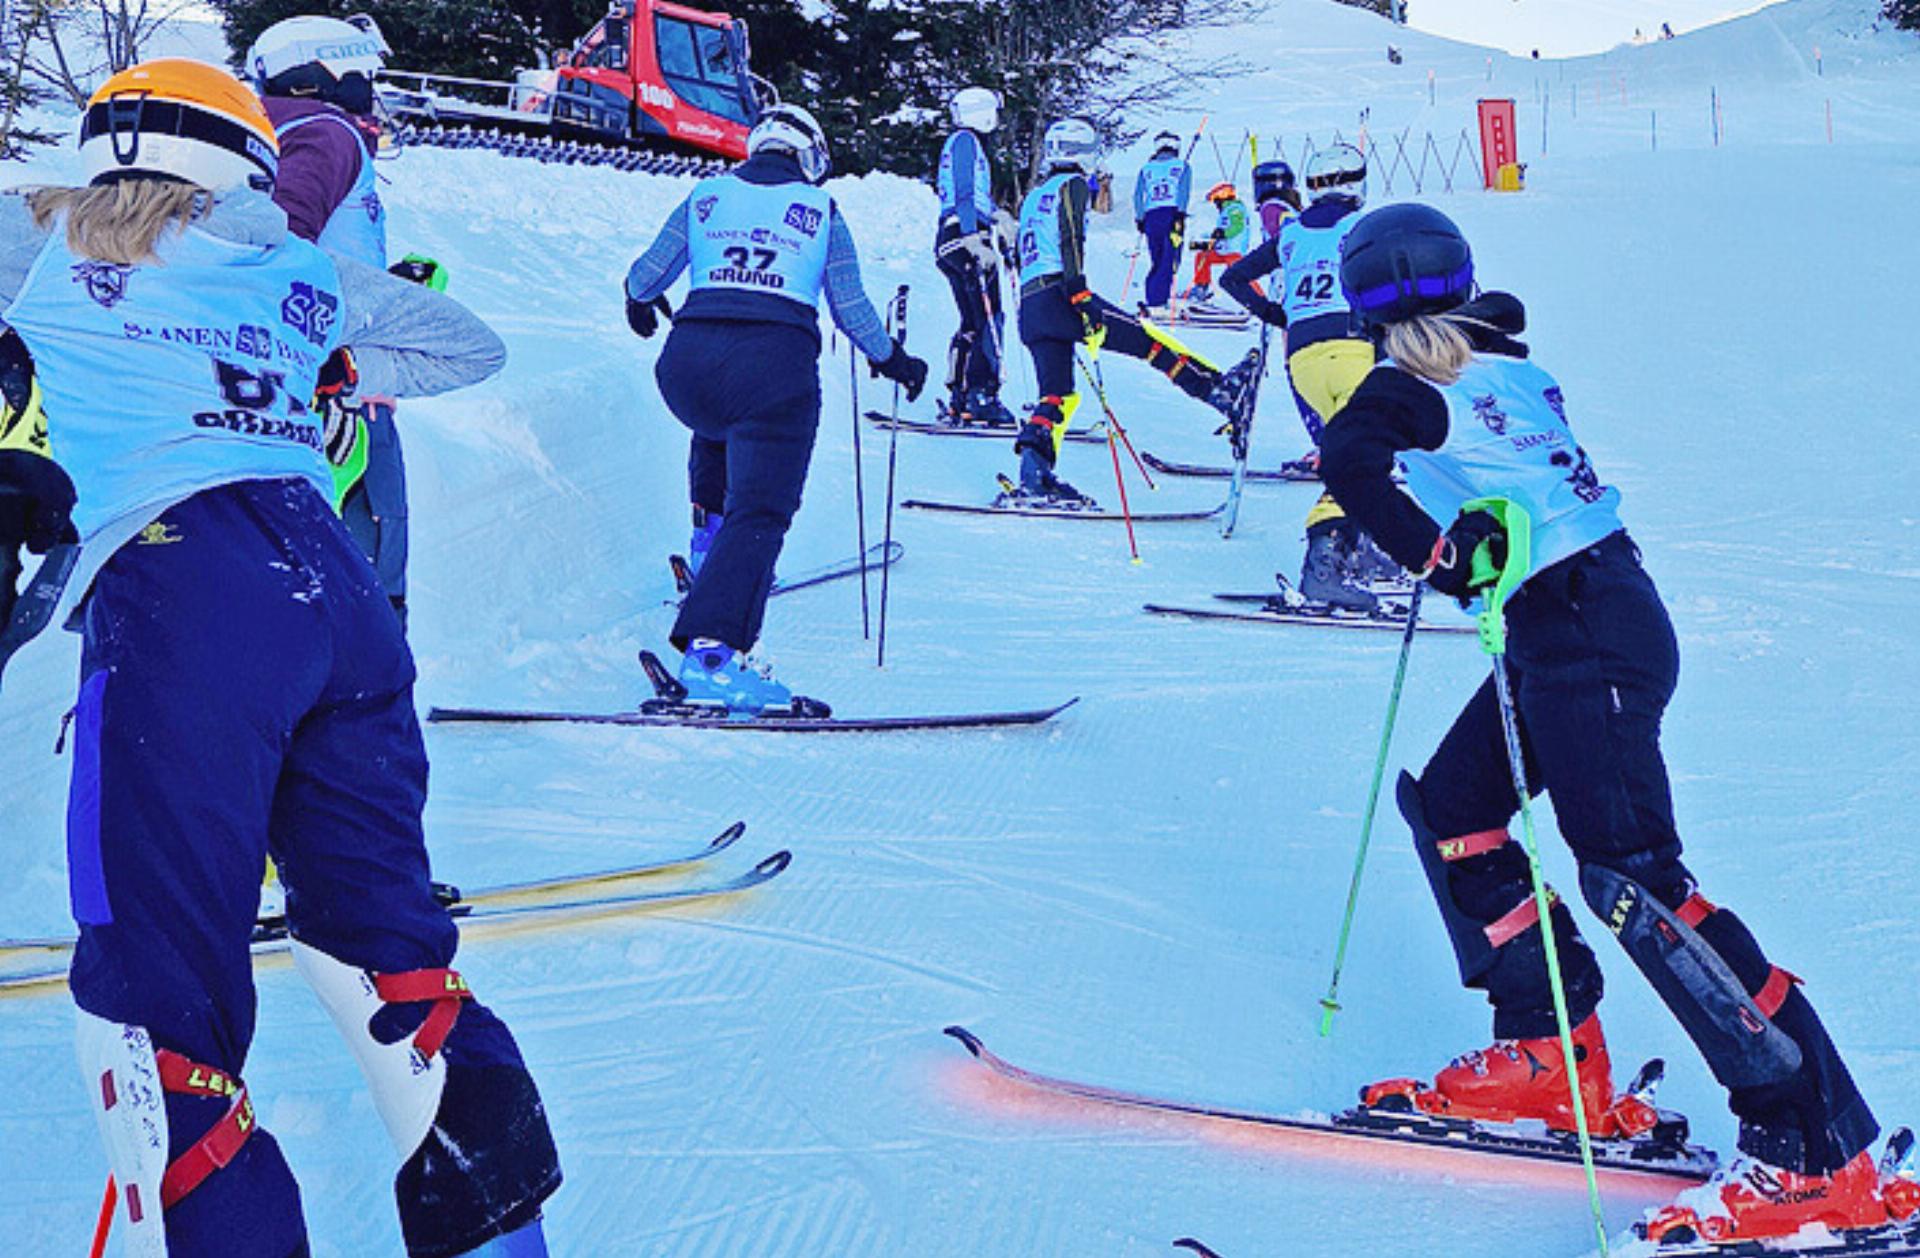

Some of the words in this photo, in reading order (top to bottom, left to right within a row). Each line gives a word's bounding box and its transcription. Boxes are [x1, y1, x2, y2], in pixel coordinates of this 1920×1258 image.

[314, 39, 379, 61] GIRO
[723, 246, 777, 270] 37
[709, 267, 784, 288] GRUND
[1296, 274, 1334, 300] 42
[1774, 1186, 1828, 1206] ATOMIC
